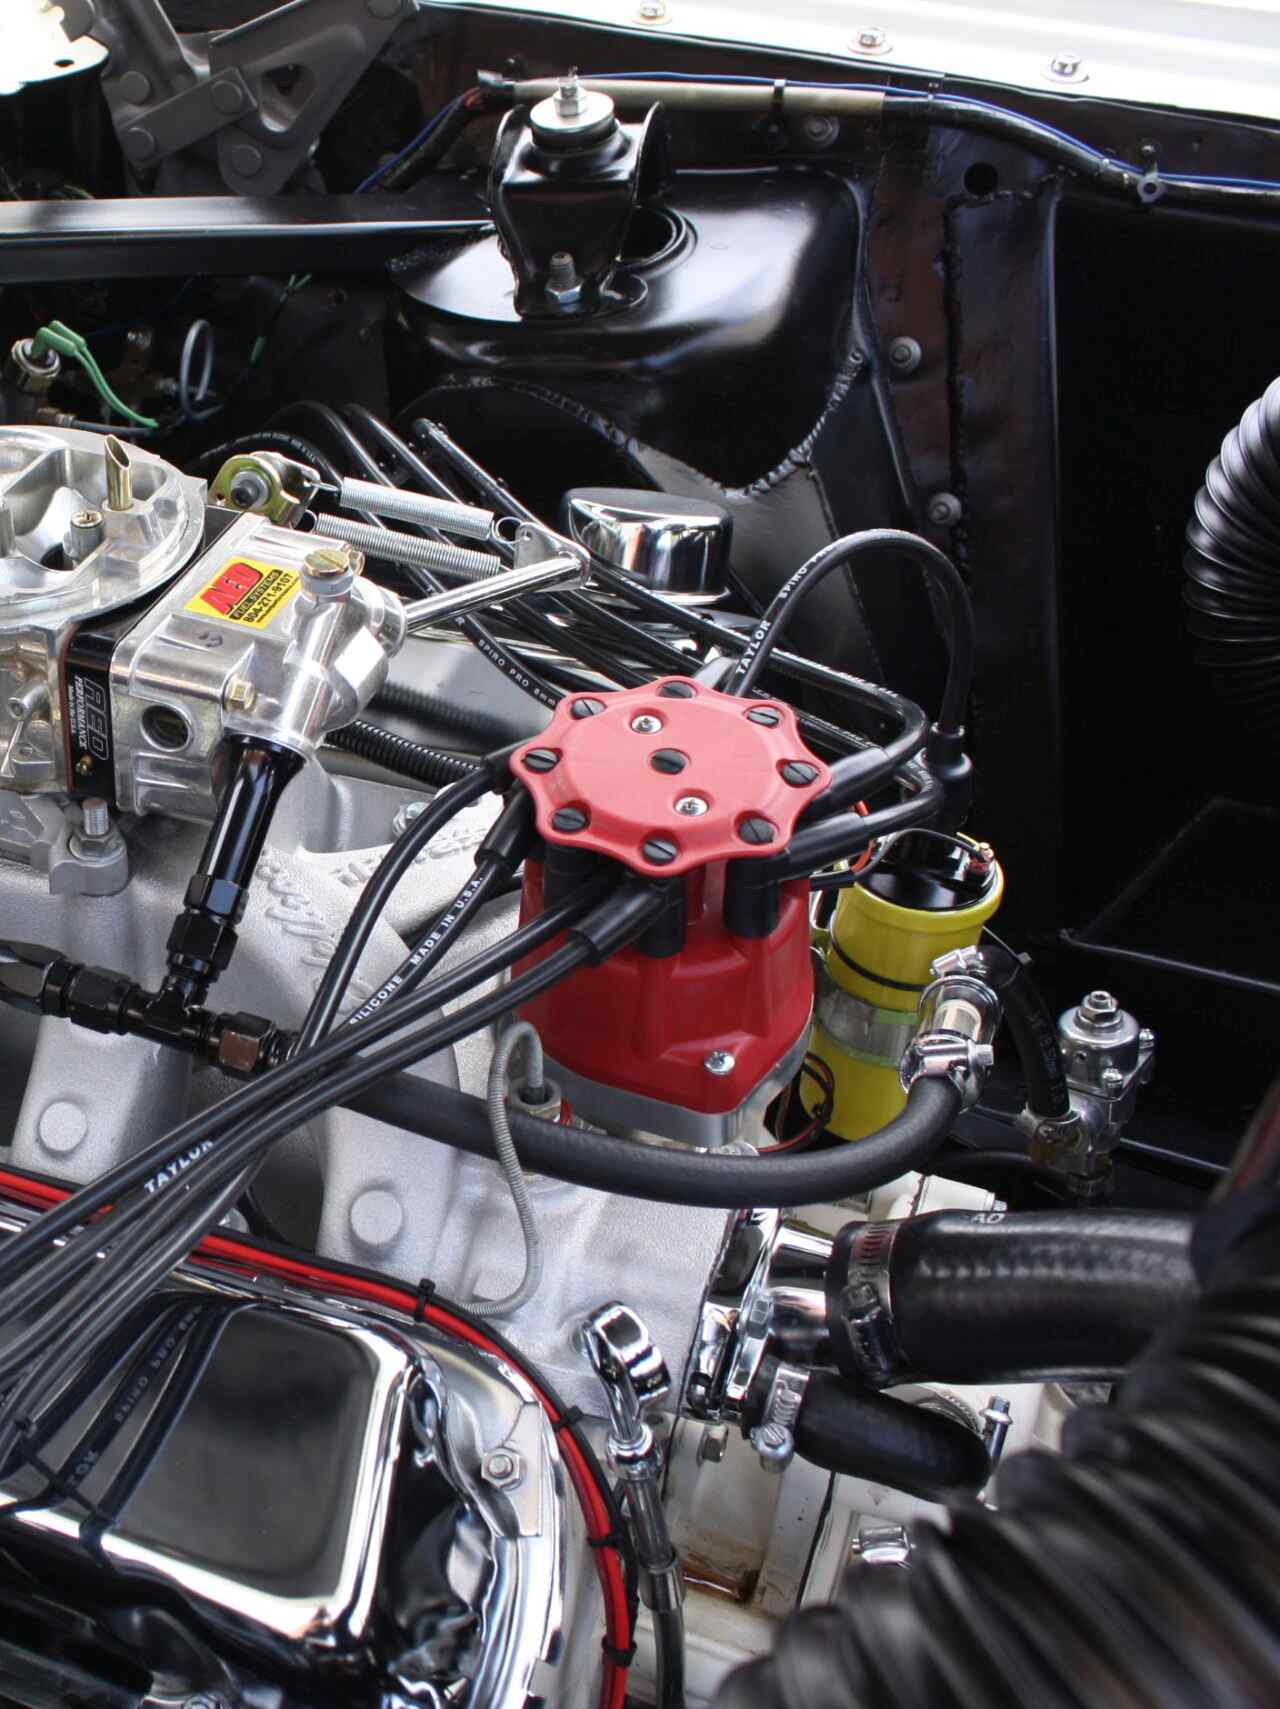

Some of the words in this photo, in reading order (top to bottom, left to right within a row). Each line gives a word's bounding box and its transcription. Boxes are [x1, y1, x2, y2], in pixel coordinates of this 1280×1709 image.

[200, 561, 264, 616] AED
[735, 620, 771, 675] TAYLOR
[778, 566, 808, 600] SPIRO
[478, 639, 505, 666] SPIRO
[509, 667, 529, 687] PRO
[74, 674, 88, 751] PERFORMANCE
[83, 677, 110, 761] AED
[348, 975, 403, 1025] SILICONE
[410, 932, 441, 965] MADE
[441, 914, 456, 928] IN
[454, 877, 484, 909] U.S.A.
[143, 1140, 214, 1193] TAYLOR
